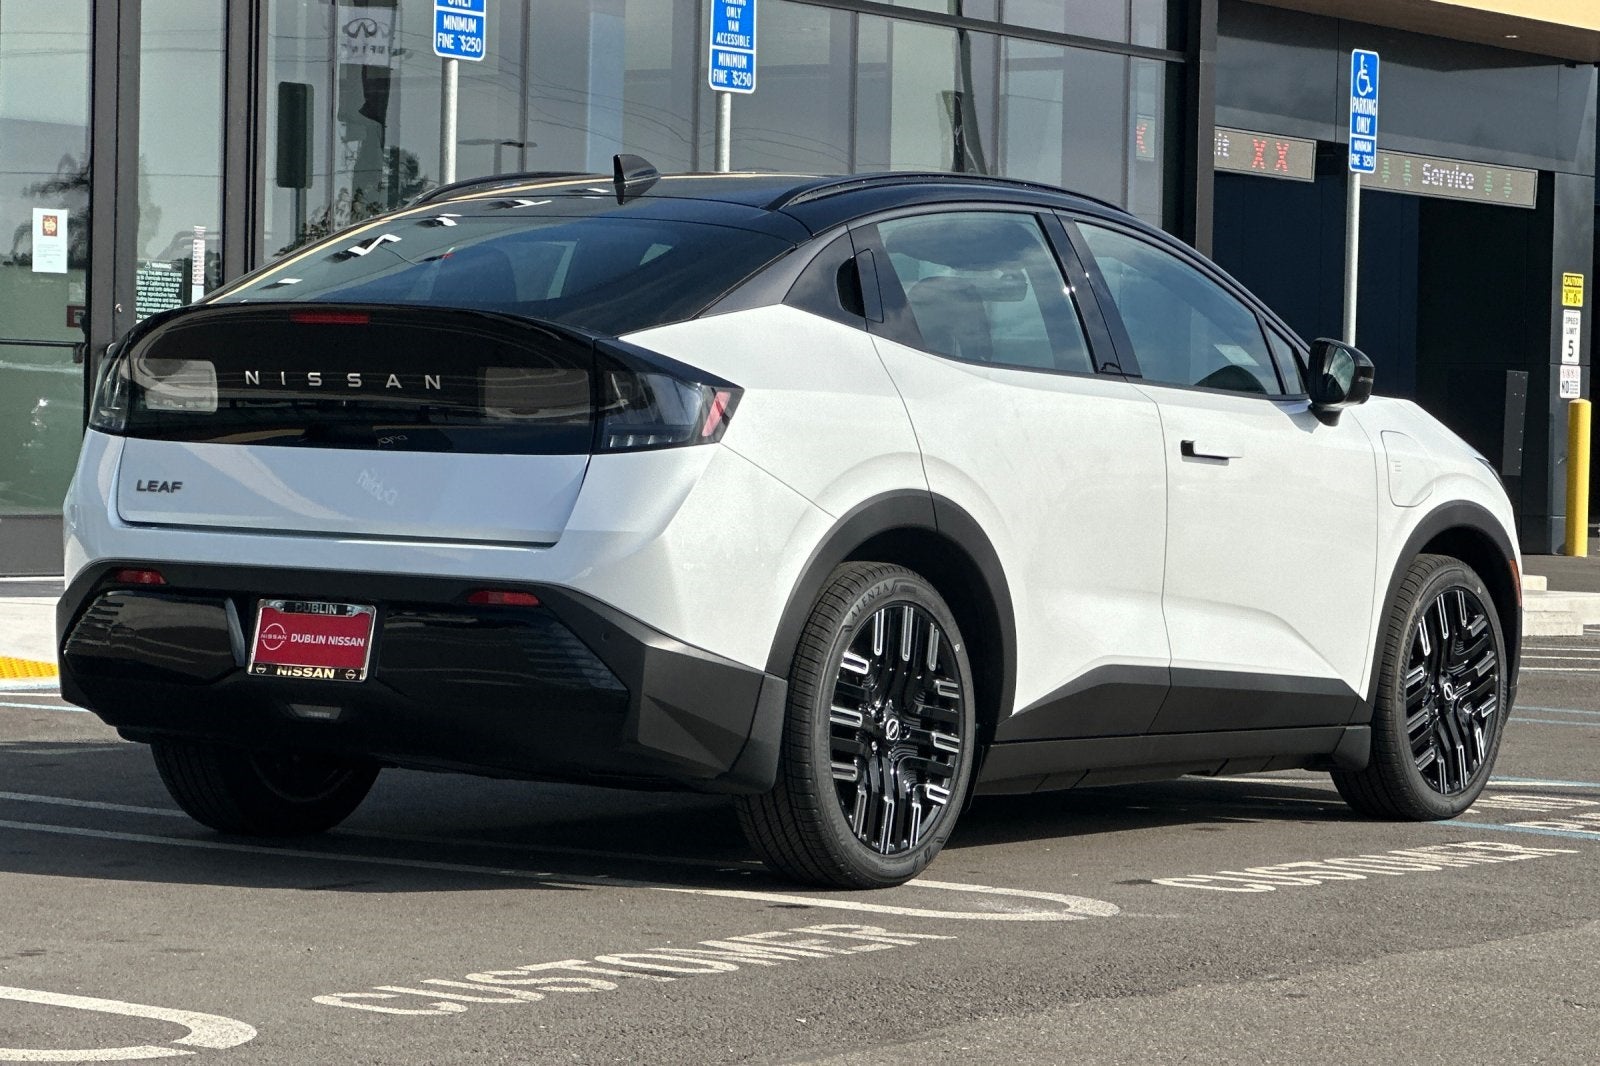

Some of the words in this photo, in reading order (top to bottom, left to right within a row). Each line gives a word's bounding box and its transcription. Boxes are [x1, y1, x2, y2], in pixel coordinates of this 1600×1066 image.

[727, 6, 742, 19] ONLY
[443, 14, 477, 34] MINIMUM
[727, 20, 740, 32] VAN
[437, 32, 455, 49] FINE
[458, 34, 482, 53] $250
[716, 32, 751, 47] ACCESSIBLE
[718, 52, 748, 69] MINIMUM
[713, 69, 728, 84] FINE
[731, 70, 752, 87] $250
[1352, 97, 1376, 116] PARKING
[1356, 115, 1371, 134] ONLY
[1354, 140, 1373, 152] MINIMUM
[1422, 163, 1475, 190] Service
[1568, 340, 1574, 357] 5
[245, 370, 441, 390] NISSAN
[136, 479, 183, 493] LEAF
[295, 602, 337, 615] DUBLIN
[290, 633, 325, 645] DUBLIN
[327, 637, 365, 647] NISSAN
[276, 666, 335, 679] NISSAN
[1151, 840, 1580, 893] CUSTOMER
[311, 923, 957, 1016] CUSTOMER
